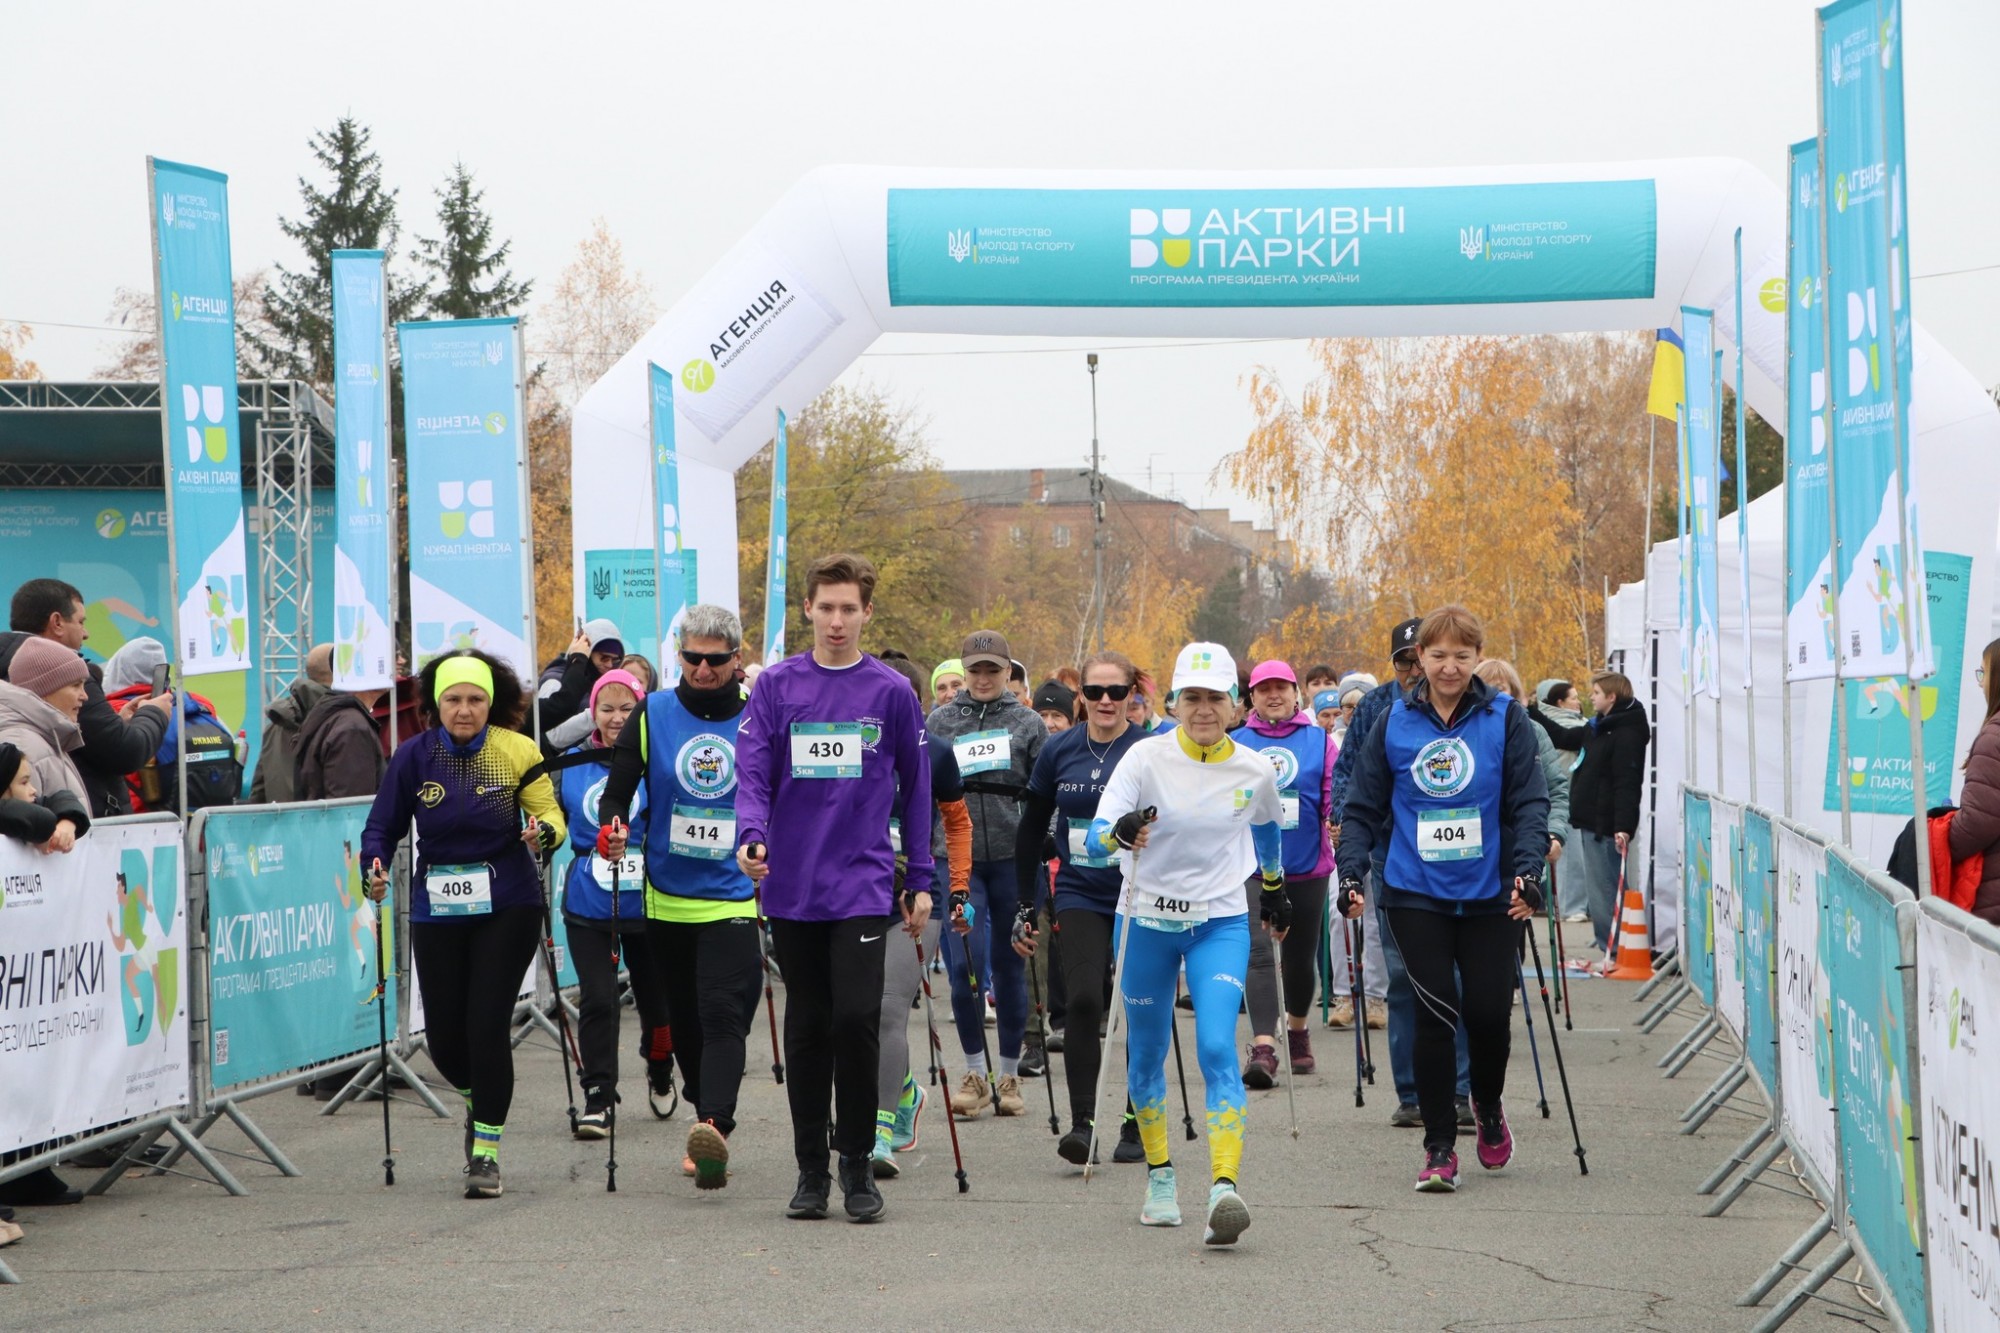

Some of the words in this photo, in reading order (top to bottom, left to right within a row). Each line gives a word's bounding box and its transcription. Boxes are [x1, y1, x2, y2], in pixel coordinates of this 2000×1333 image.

[1199, 205, 1405, 236] АКТИВНІ
[1491, 221, 1568, 233] МІНІСТЕРСТВО
[978, 227, 1052, 238] МІНІСТЕРСТВО
[1491, 236, 1534, 247] МОЛОДІ
[1535, 236, 1548, 245] ТА
[1549, 234, 1592, 245] СПОРТУ
[978, 241, 1018, 252] МОЛОДІ
[1020, 242, 1035, 251] ТА
[1035, 242, 1075, 252] СПОРТУ
[1199, 237, 1360, 268] ПАРКИ
[978, 254, 1020, 265] УКРАЇНИ
[1491, 250, 1534, 261] УКРАЇНИ
[1131, 275, 1204, 285] ПРОГРАМА
[1208, 275, 1298, 286] ПРЕЗИДЕНТА
[1302, 273, 1360, 285] УКРАЇНИ
[709, 280, 787, 361] АГЕНЦІЯ
[720, 339, 751, 369] МАСОВОГО
[750, 318, 772, 340] СПОРТУ
[623, 590, 634, 598] ТА
[192, 736, 222, 746] UKRAINE
[809, 742, 844, 758] 430
[968, 743, 996, 757] 429
[686, 824, 719, 841] 414
[1433, 826, 1466, 842] 404
[5, 873, 43, 896] АГЕНЦІЯ
[441, 881, 473, 897] 408
[1154, 896, 1190, 914] 440
[213, 909, 284, 966] АКТИВНІ
[286, 902, 336, 953] ПАРКИ
[39, 940, 105, 1006] ПАРКИ
